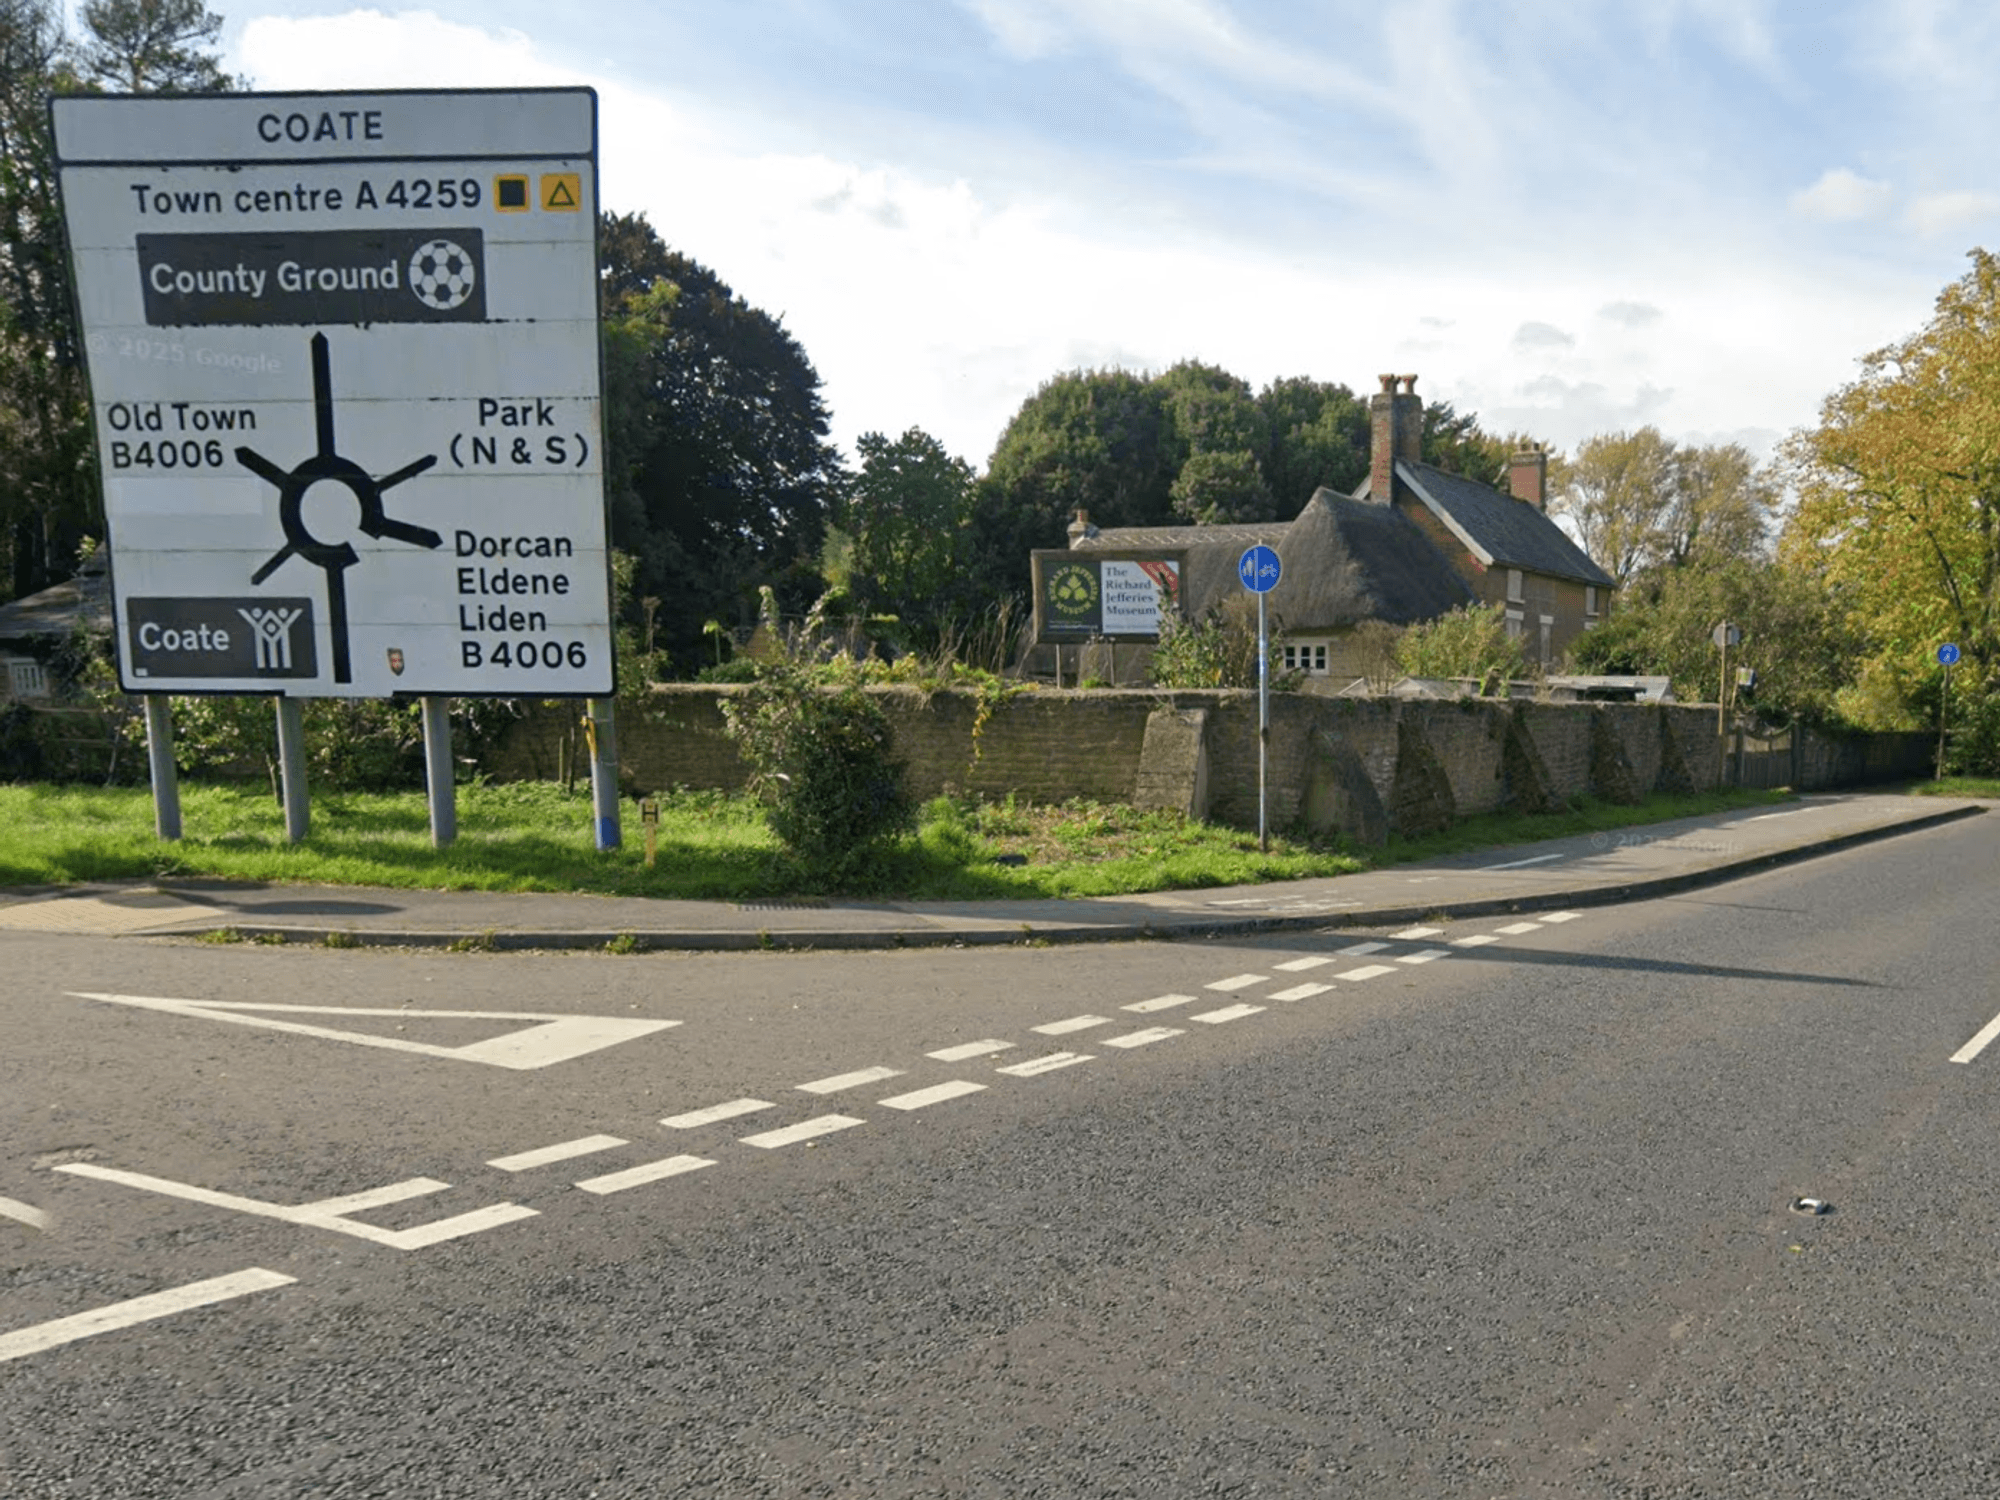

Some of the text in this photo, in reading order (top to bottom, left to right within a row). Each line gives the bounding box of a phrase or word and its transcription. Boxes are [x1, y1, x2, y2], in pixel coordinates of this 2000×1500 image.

[257, 111, 383, 143] COATE
[130, 184, 222, 215] Town
[234, 183, 343, 214] centre
[150, 259, 399, 298] County Ground
[107, 401, 257, 432] Old Town
[478, 399, 554, 427] Park
[111, 439, 224, 469] B4006
[455, 529, 573, 559] Dorcan
[457, 567, 570, 595] Eldene
[1105, 566, 1128, 577] The
[1106, 579, 1151, 590] Richard
[1106, 592, 1154, 603] Jefferies
[1106, 605, 1157, 616] Museum
[459, 604, 547, 632] Liden
[139, 622, 231, 652] Coate
